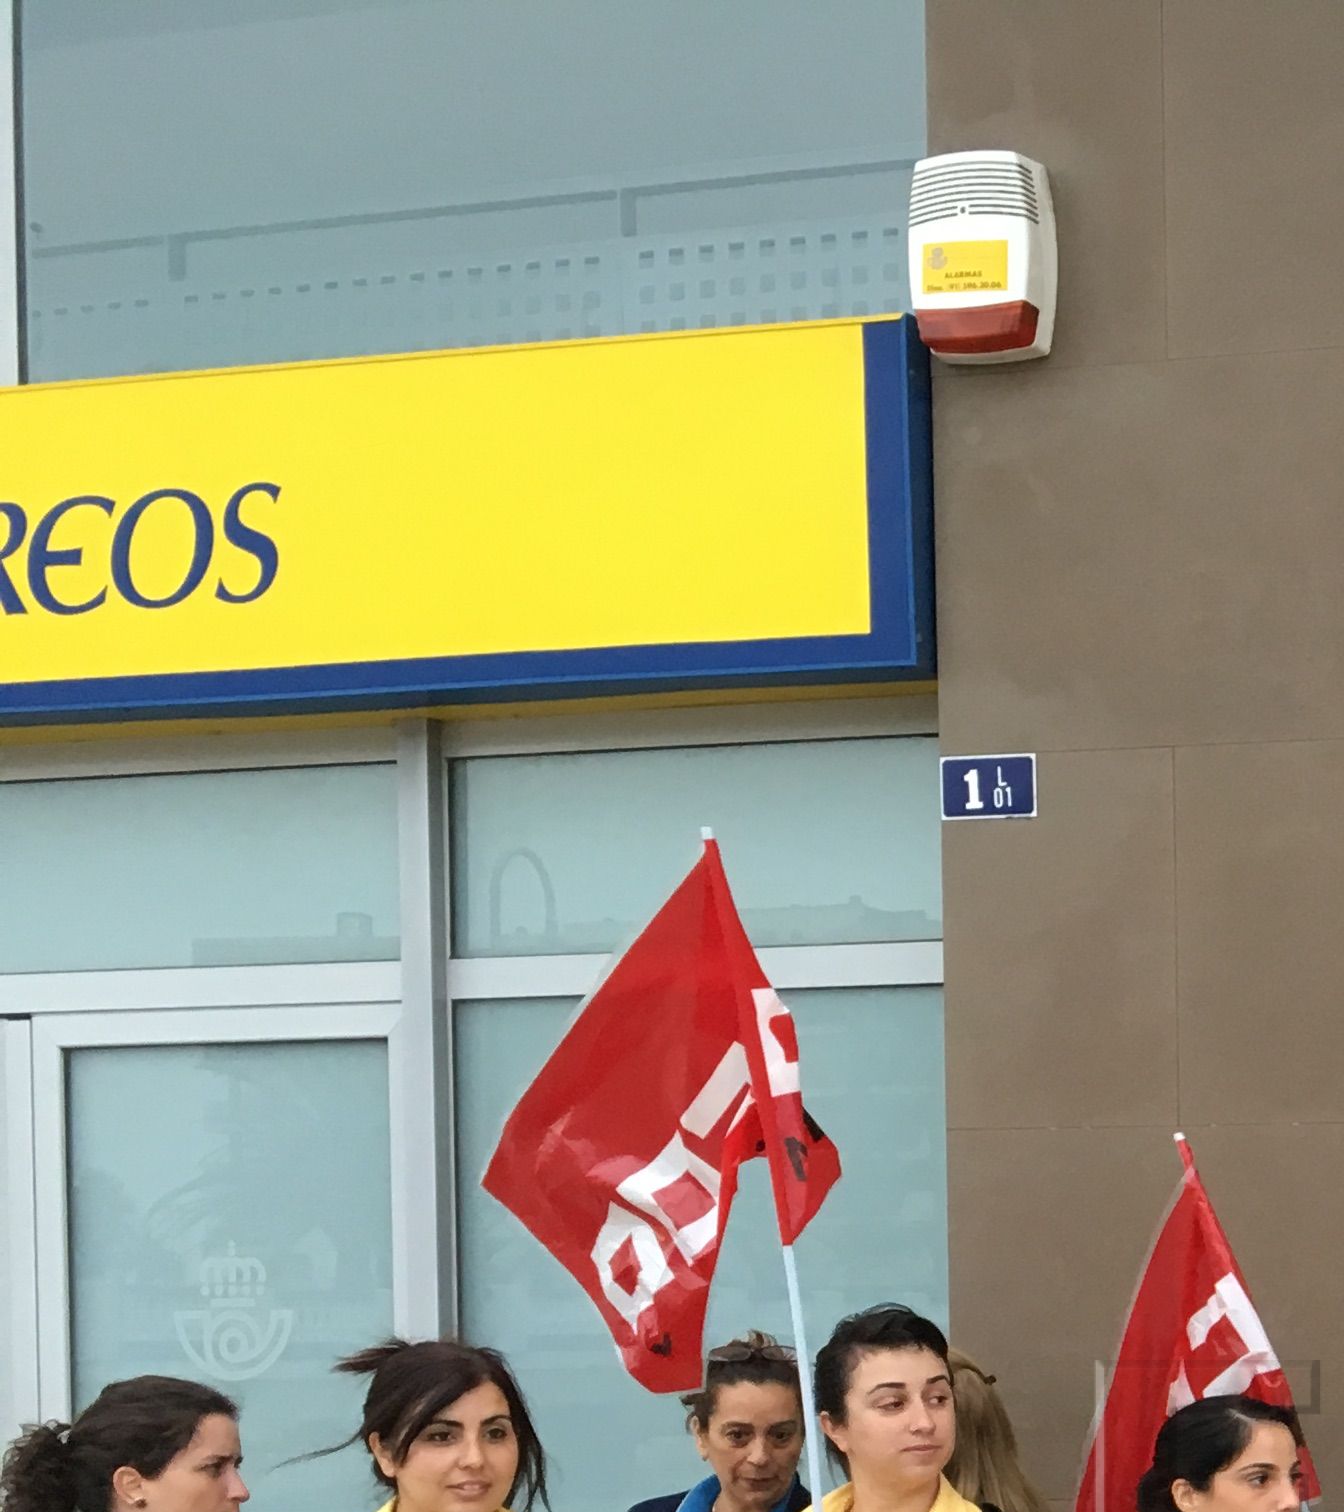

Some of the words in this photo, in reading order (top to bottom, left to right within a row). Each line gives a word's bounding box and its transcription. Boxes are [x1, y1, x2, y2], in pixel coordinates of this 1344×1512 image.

[944, 270, 983, 279] ALARMAS
[997, 765, 1008, 787] L
[963, 768, 984, 810] 1
[993, 786, 1013, 808] 01
